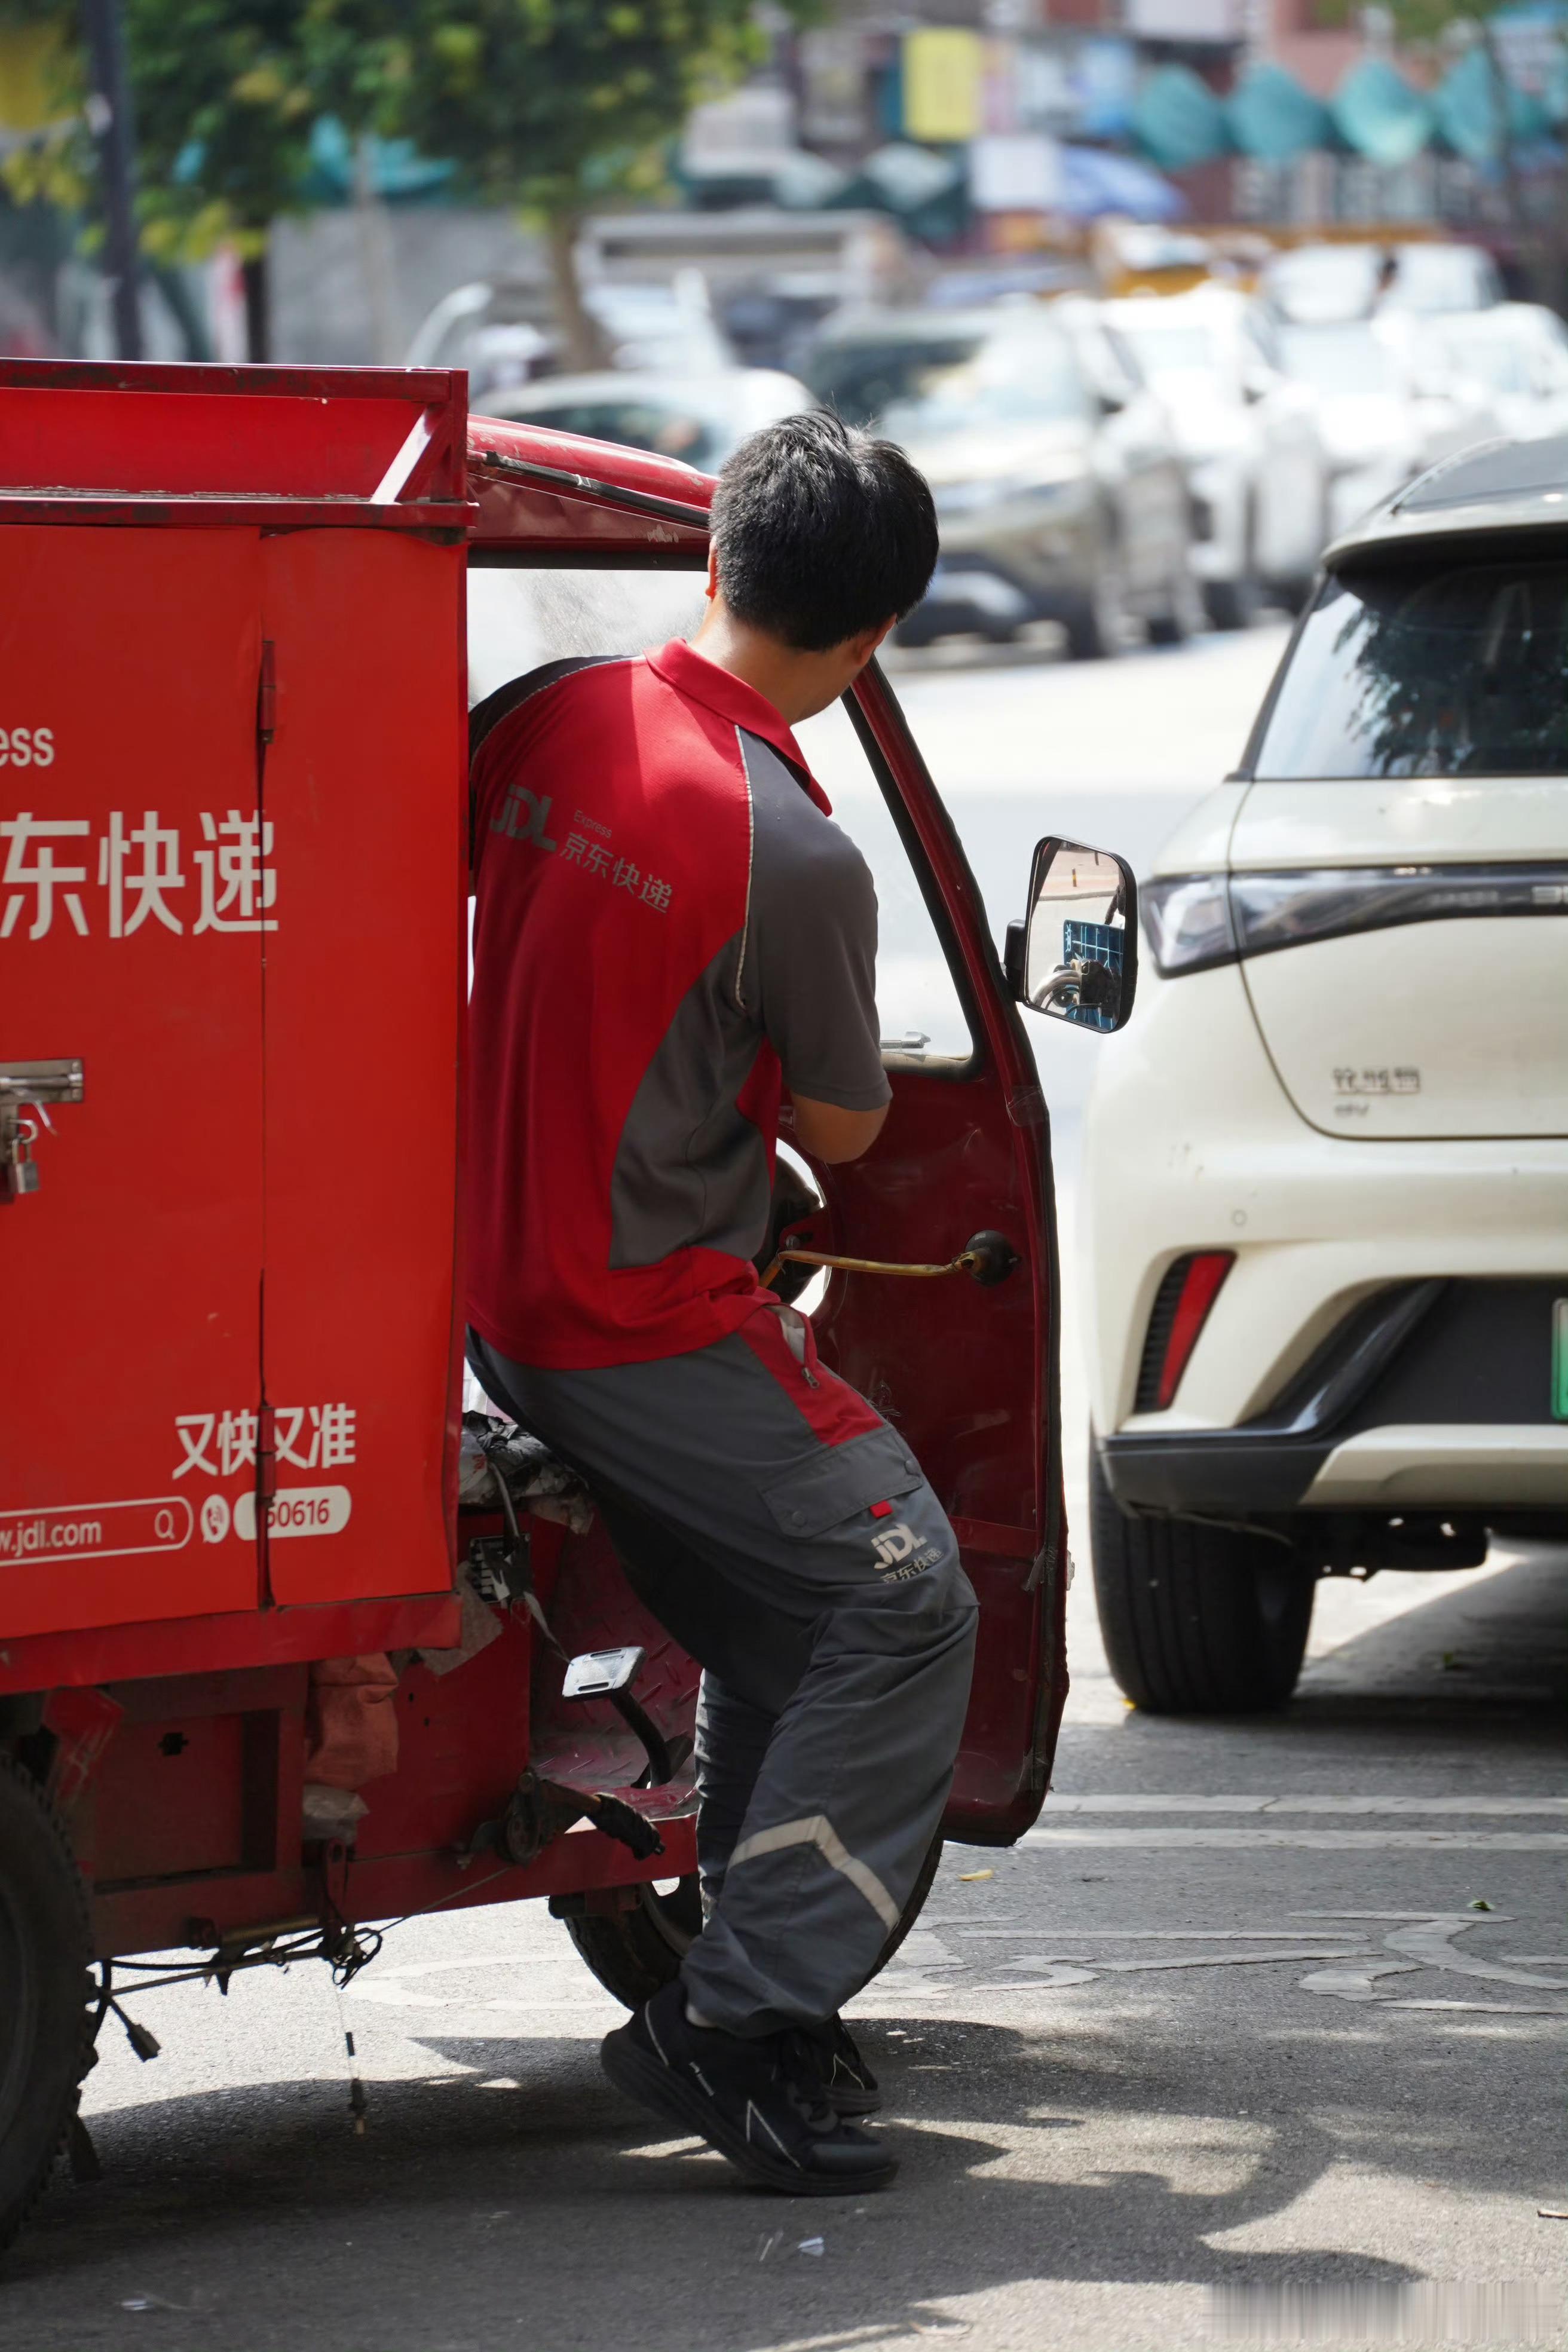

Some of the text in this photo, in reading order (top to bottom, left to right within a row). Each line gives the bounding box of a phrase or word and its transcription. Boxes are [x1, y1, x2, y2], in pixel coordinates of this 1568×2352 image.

[489, 783, 557, 852] JDL
[573, 809, 612, 838] Express
[0, 810, 278, 941] 东快递
[559, 832, 673, 914] 京东快递
[172, 1402, 356, 1480] 又快又准
